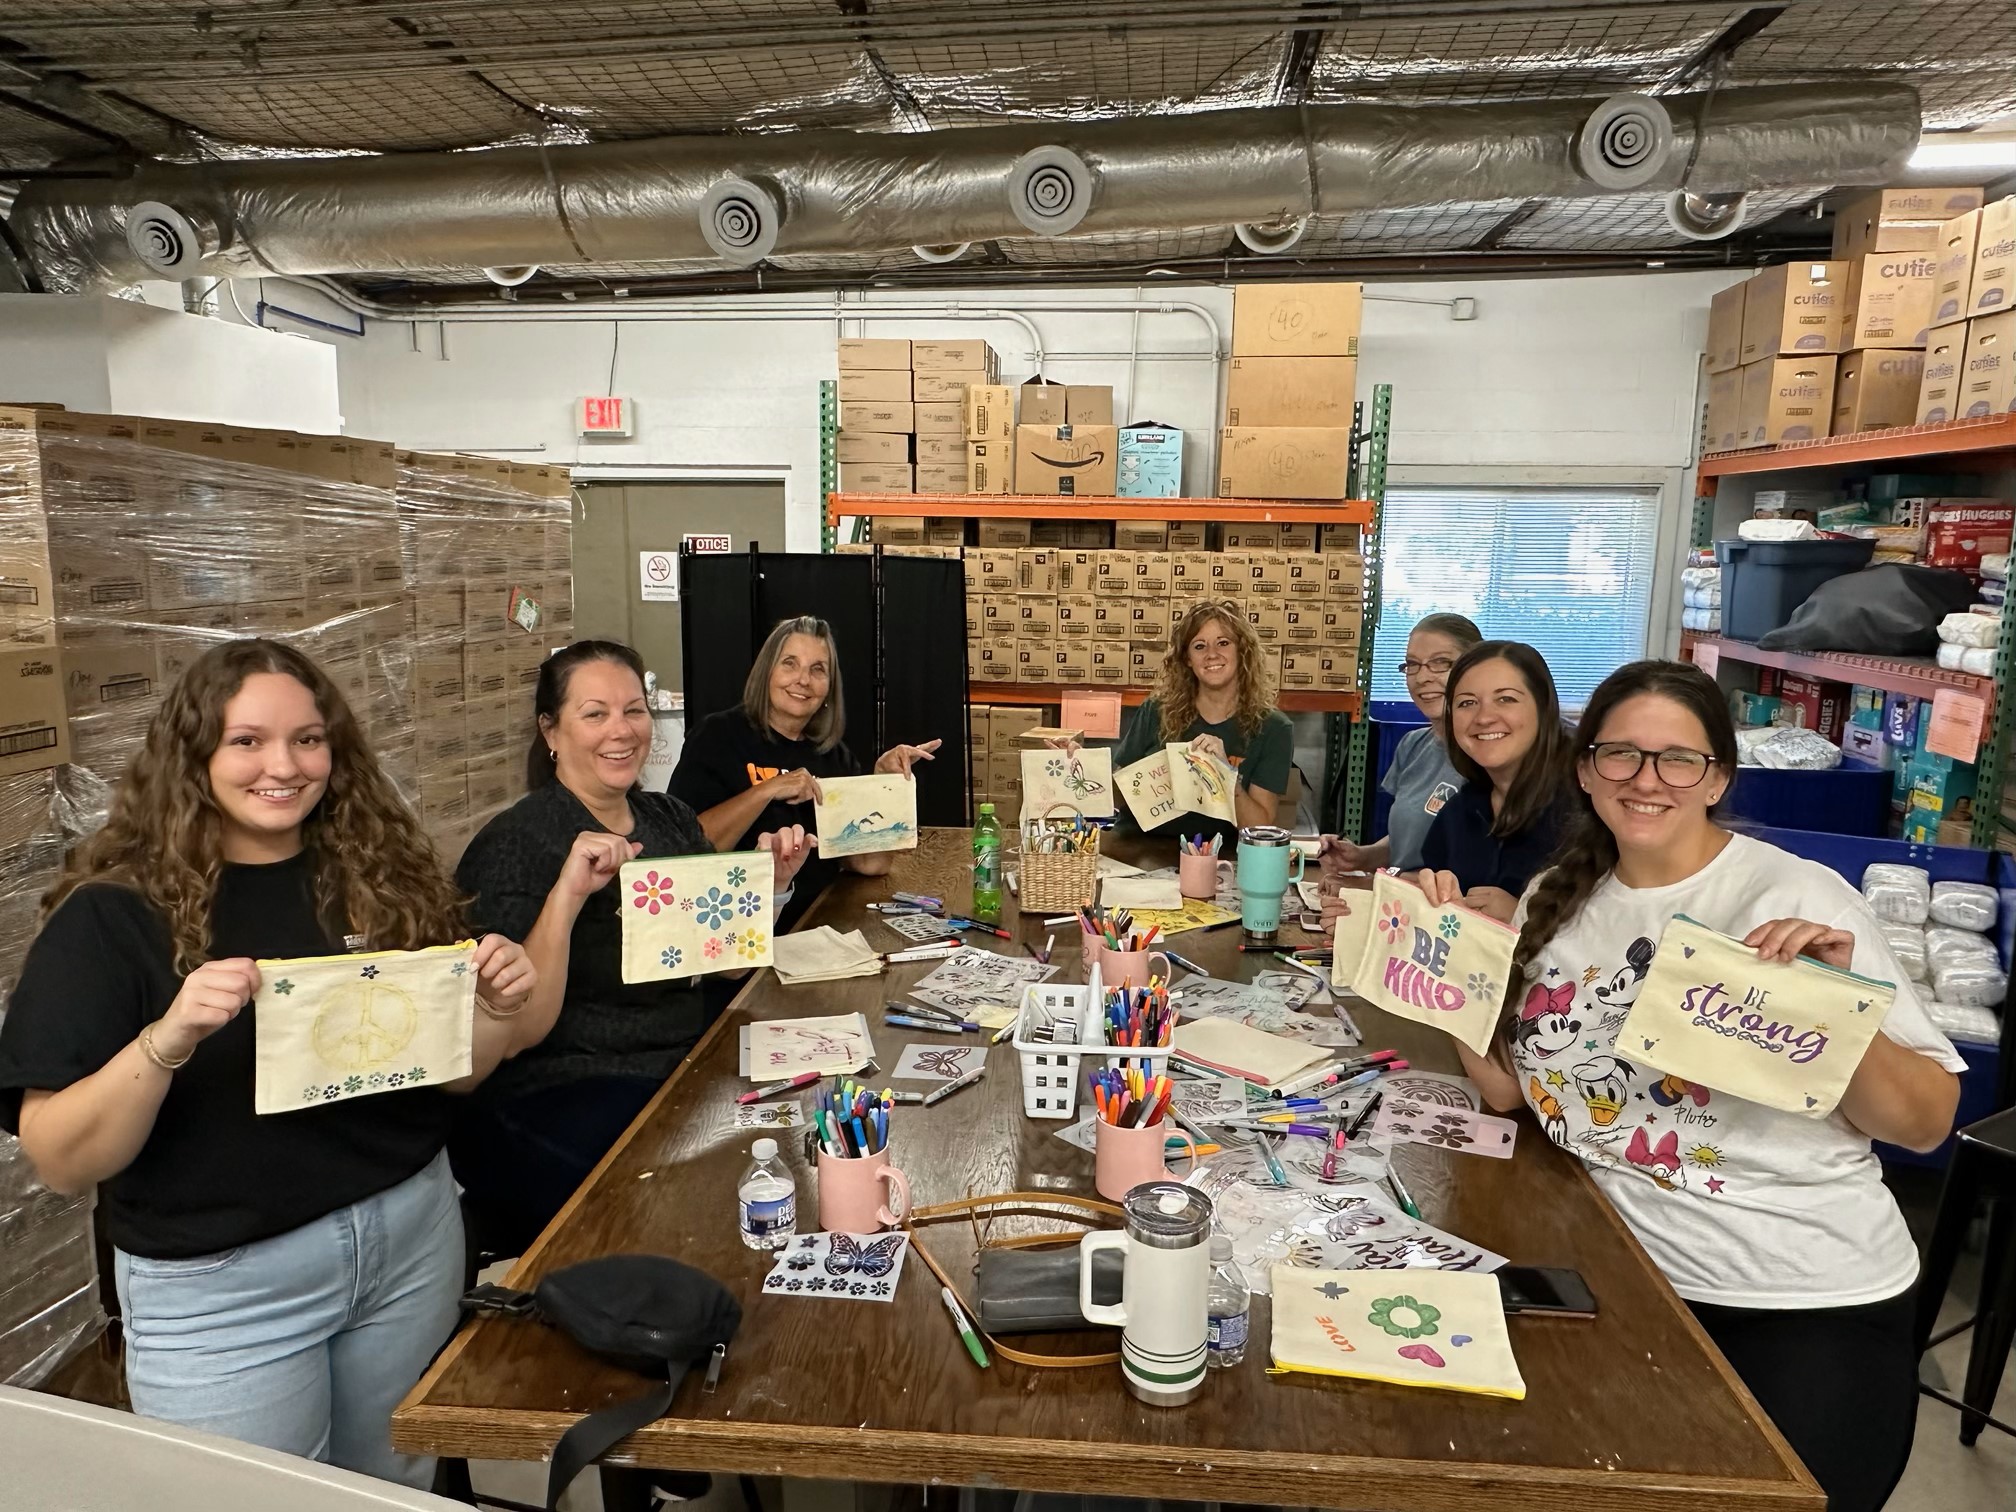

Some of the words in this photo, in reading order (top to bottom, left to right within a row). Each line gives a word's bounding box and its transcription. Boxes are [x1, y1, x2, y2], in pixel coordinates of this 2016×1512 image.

[1880, 257, 1936, 279] cutie
[1277, 308, 1303, 331] 40
[585, 399, 622, 428] EXIT
[1961, 510, 2012, 520] HUGGIES
[1411, 926, 1450, 978] BE
[1384, 957, 1467, 1012] KIND
[1743, 986, 1771, 1011] BE
[1680, 983, 1829, 1064] strong
[1315, 1316, 1356, 1352] LOVE
